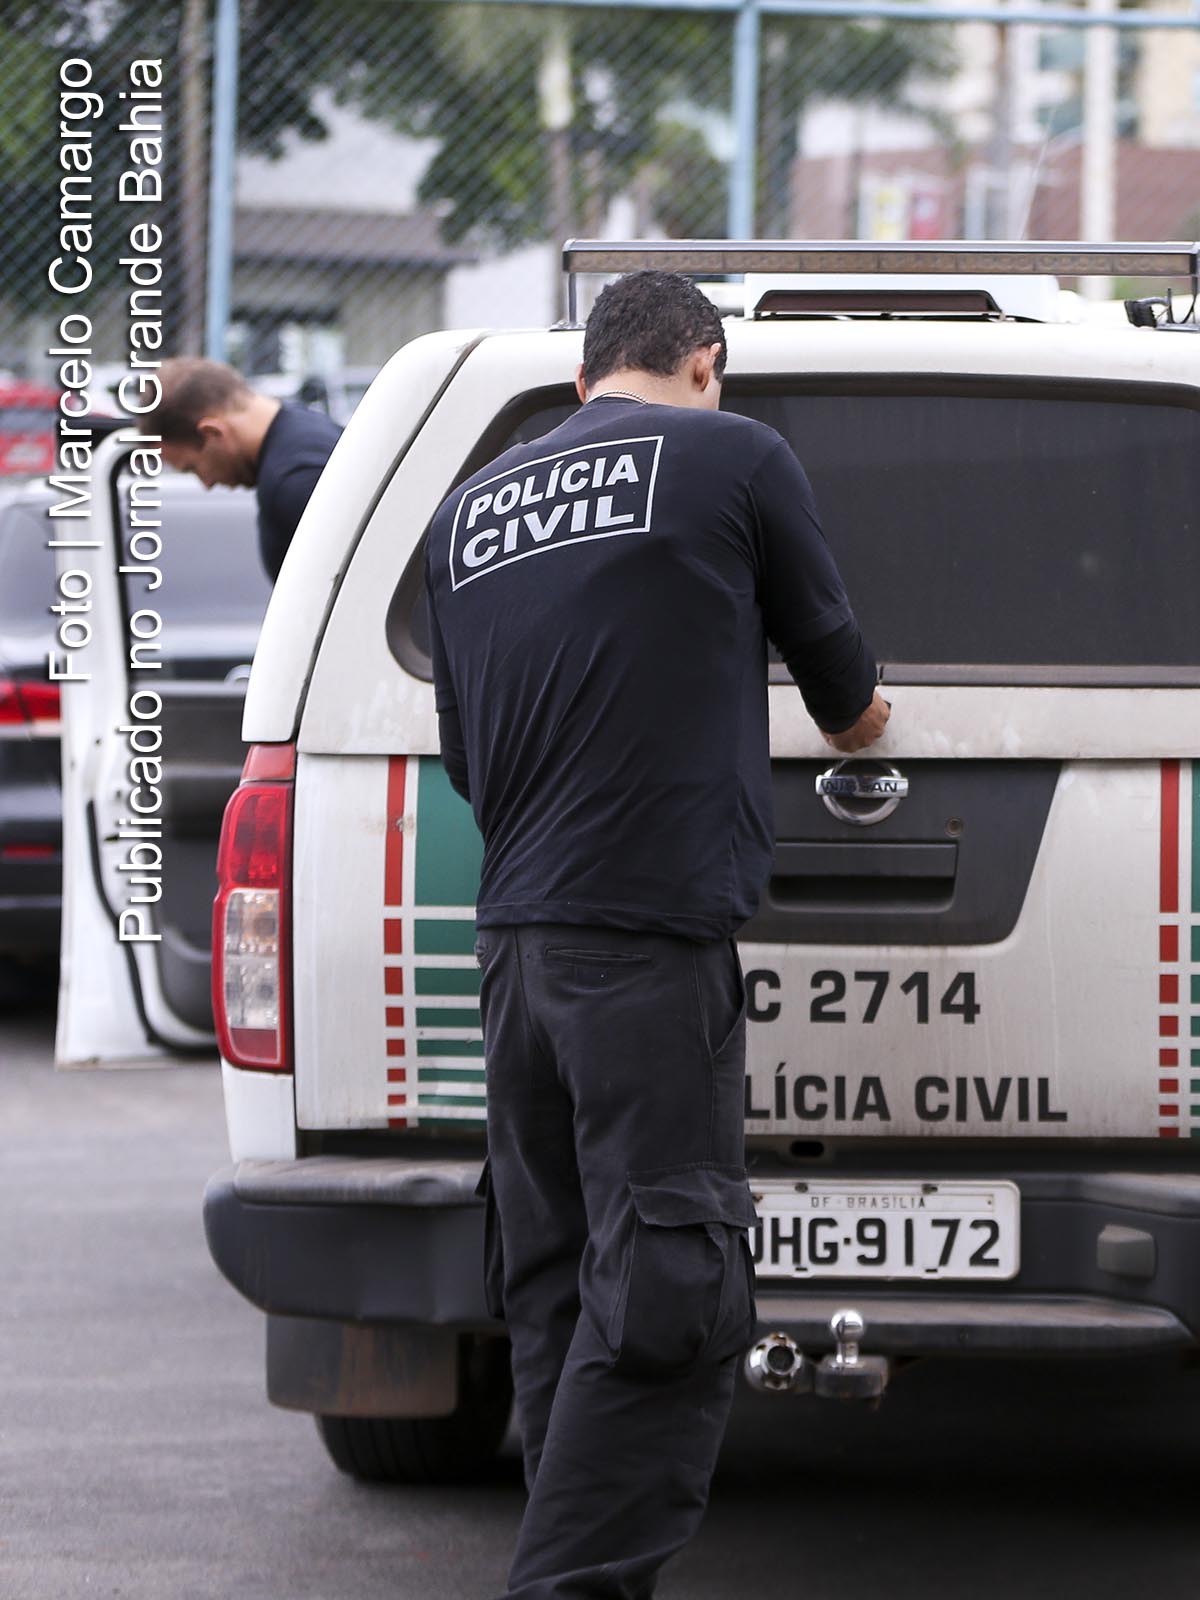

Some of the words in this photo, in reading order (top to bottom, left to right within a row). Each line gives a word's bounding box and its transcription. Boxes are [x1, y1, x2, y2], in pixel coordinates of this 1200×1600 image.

[466, 454, 639, 530] POLÍCIA
[462, 495, 635, 568] CIVIL
[810, 971, 981, 1024] 2714
[744, 1061, 891, 1121] LÍCIA
[915, 1075, 1068, 1122] CIVIL
